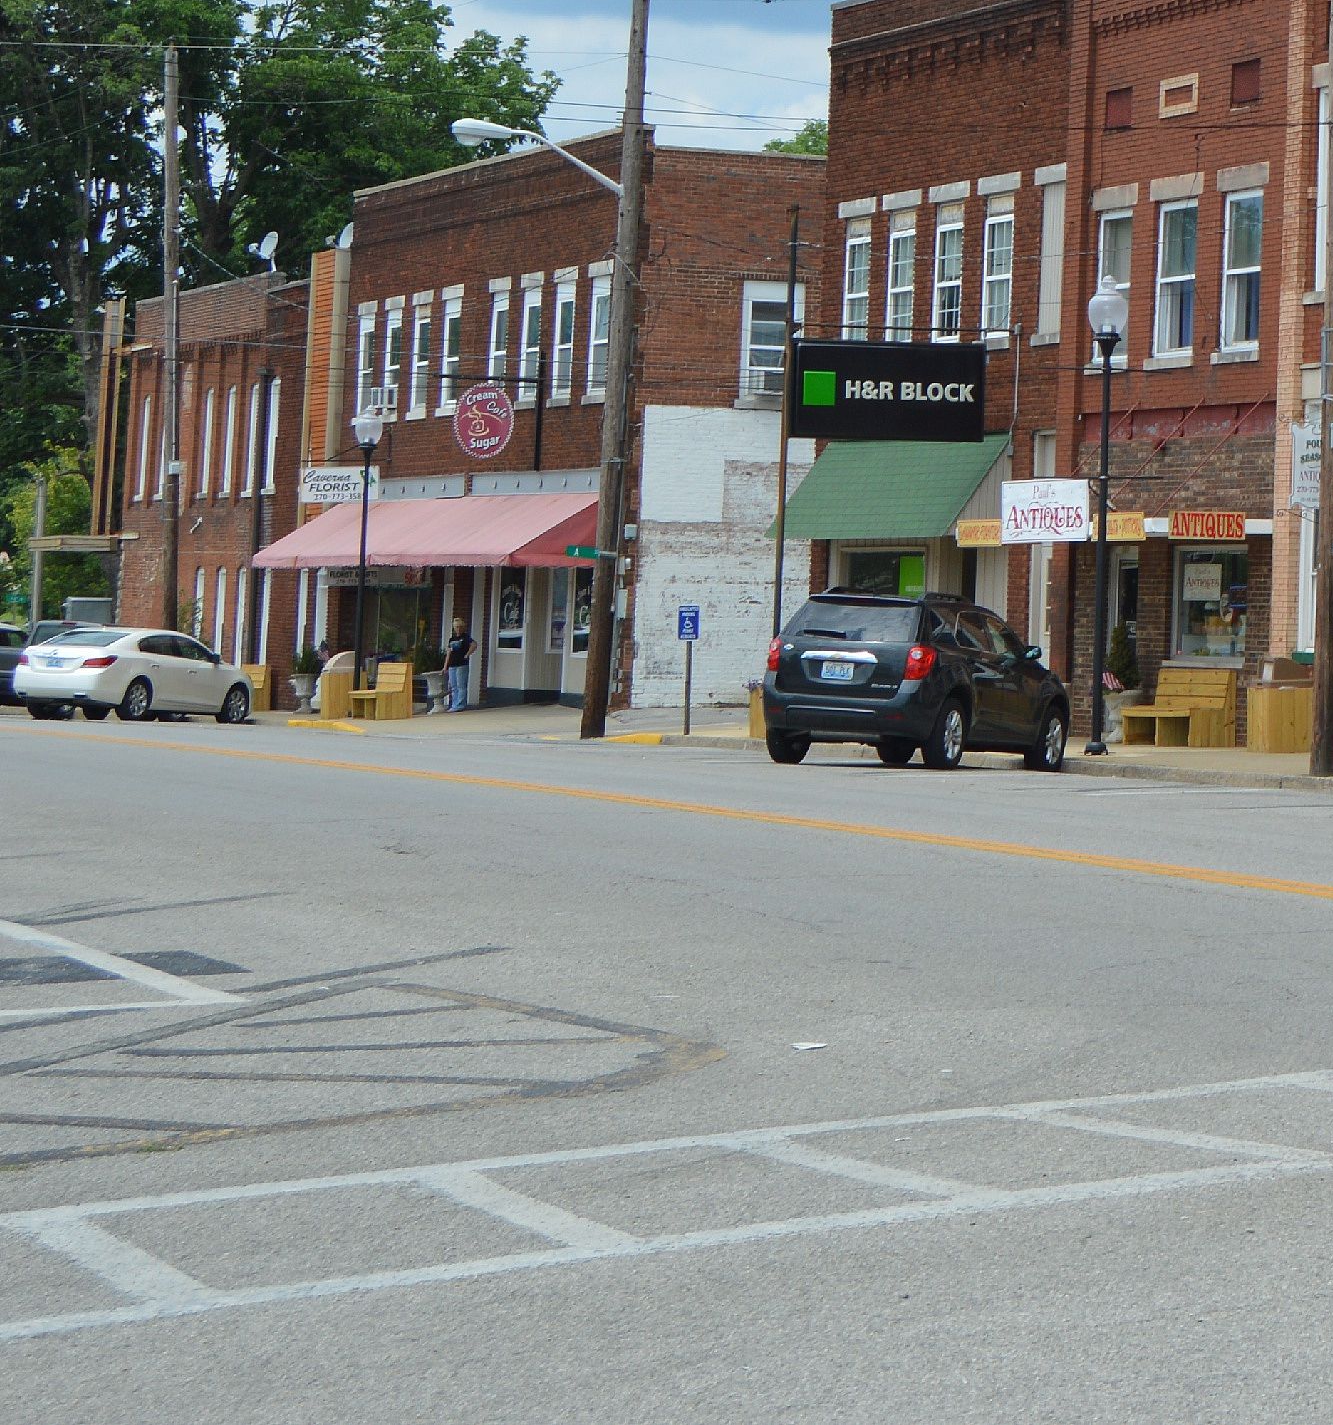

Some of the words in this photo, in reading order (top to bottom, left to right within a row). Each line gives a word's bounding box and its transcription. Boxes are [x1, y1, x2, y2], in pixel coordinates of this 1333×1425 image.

[466, 391, 498, 406] Cream
[845, 379, 894, 401] H&R
[900, 381, 975, 403] BLOCK
[470, 436, 501, 450] Sugar
[1306, 439, 1322, 449] FOU
[309, 482, 360, 493] FLORIST
[1006, 504, 1083, 535] ANTIQUES
[1171, 511, 1245, 539] ANTIQUES
